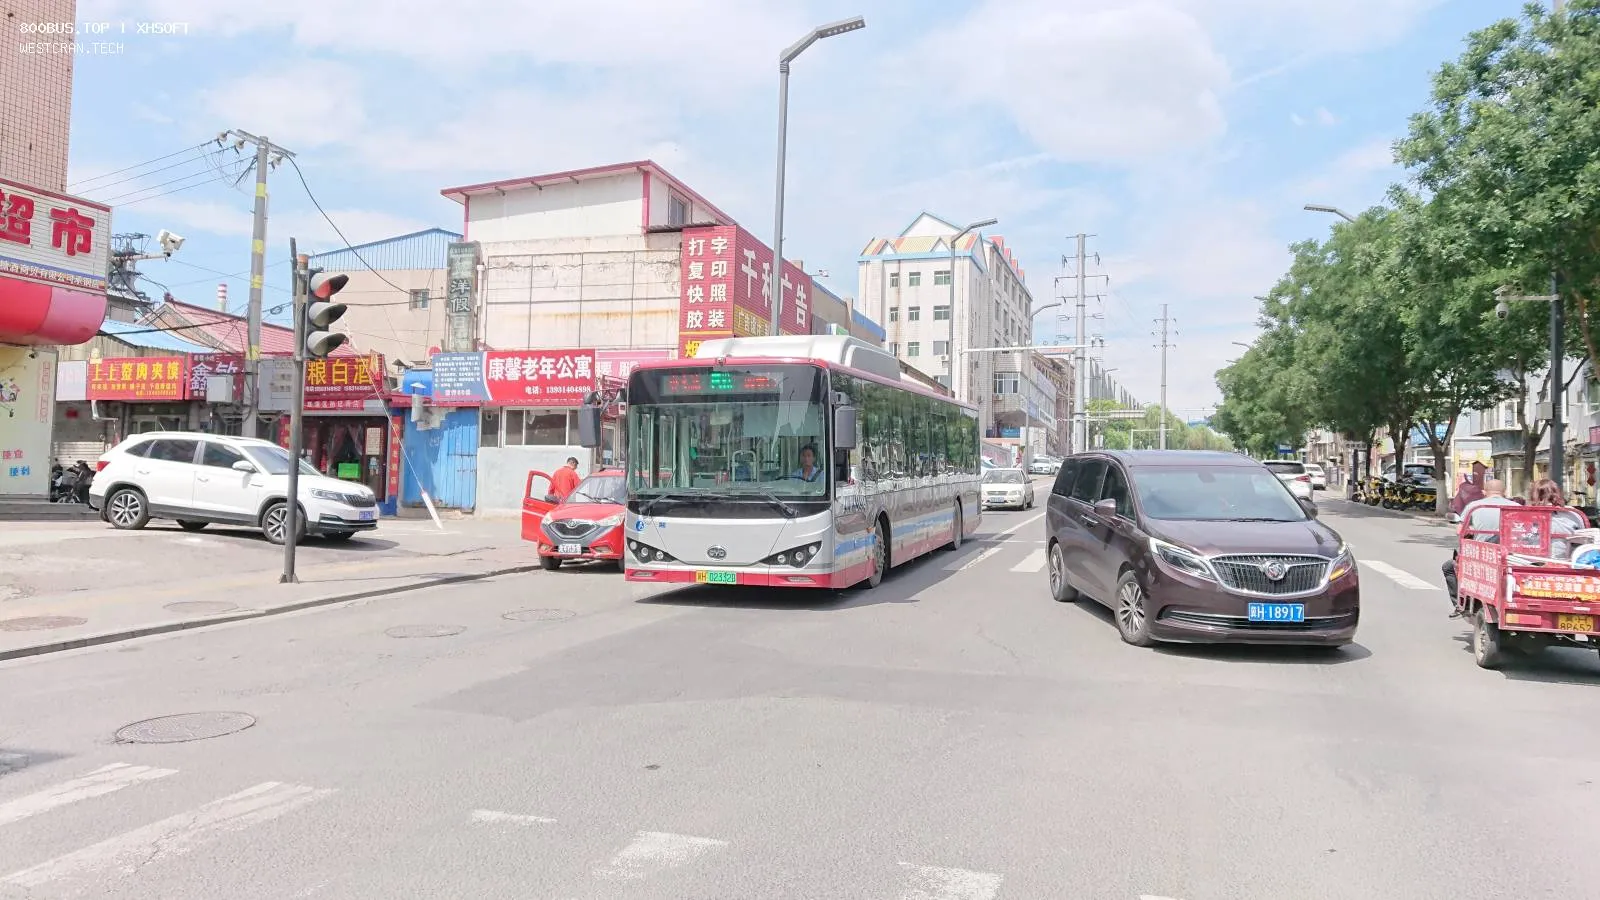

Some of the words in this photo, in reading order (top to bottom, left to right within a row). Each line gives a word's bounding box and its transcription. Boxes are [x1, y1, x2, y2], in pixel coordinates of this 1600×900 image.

[0, 188, 95, 257] 超市
[688, 236, 728, 256] 打字
[687, 260, 728, 280] 复印
[686, 283, 727, 304] 快照
[686, 308, 726, 329] 胶装
[487, 356, 592, 381] 康馨老年公寓
